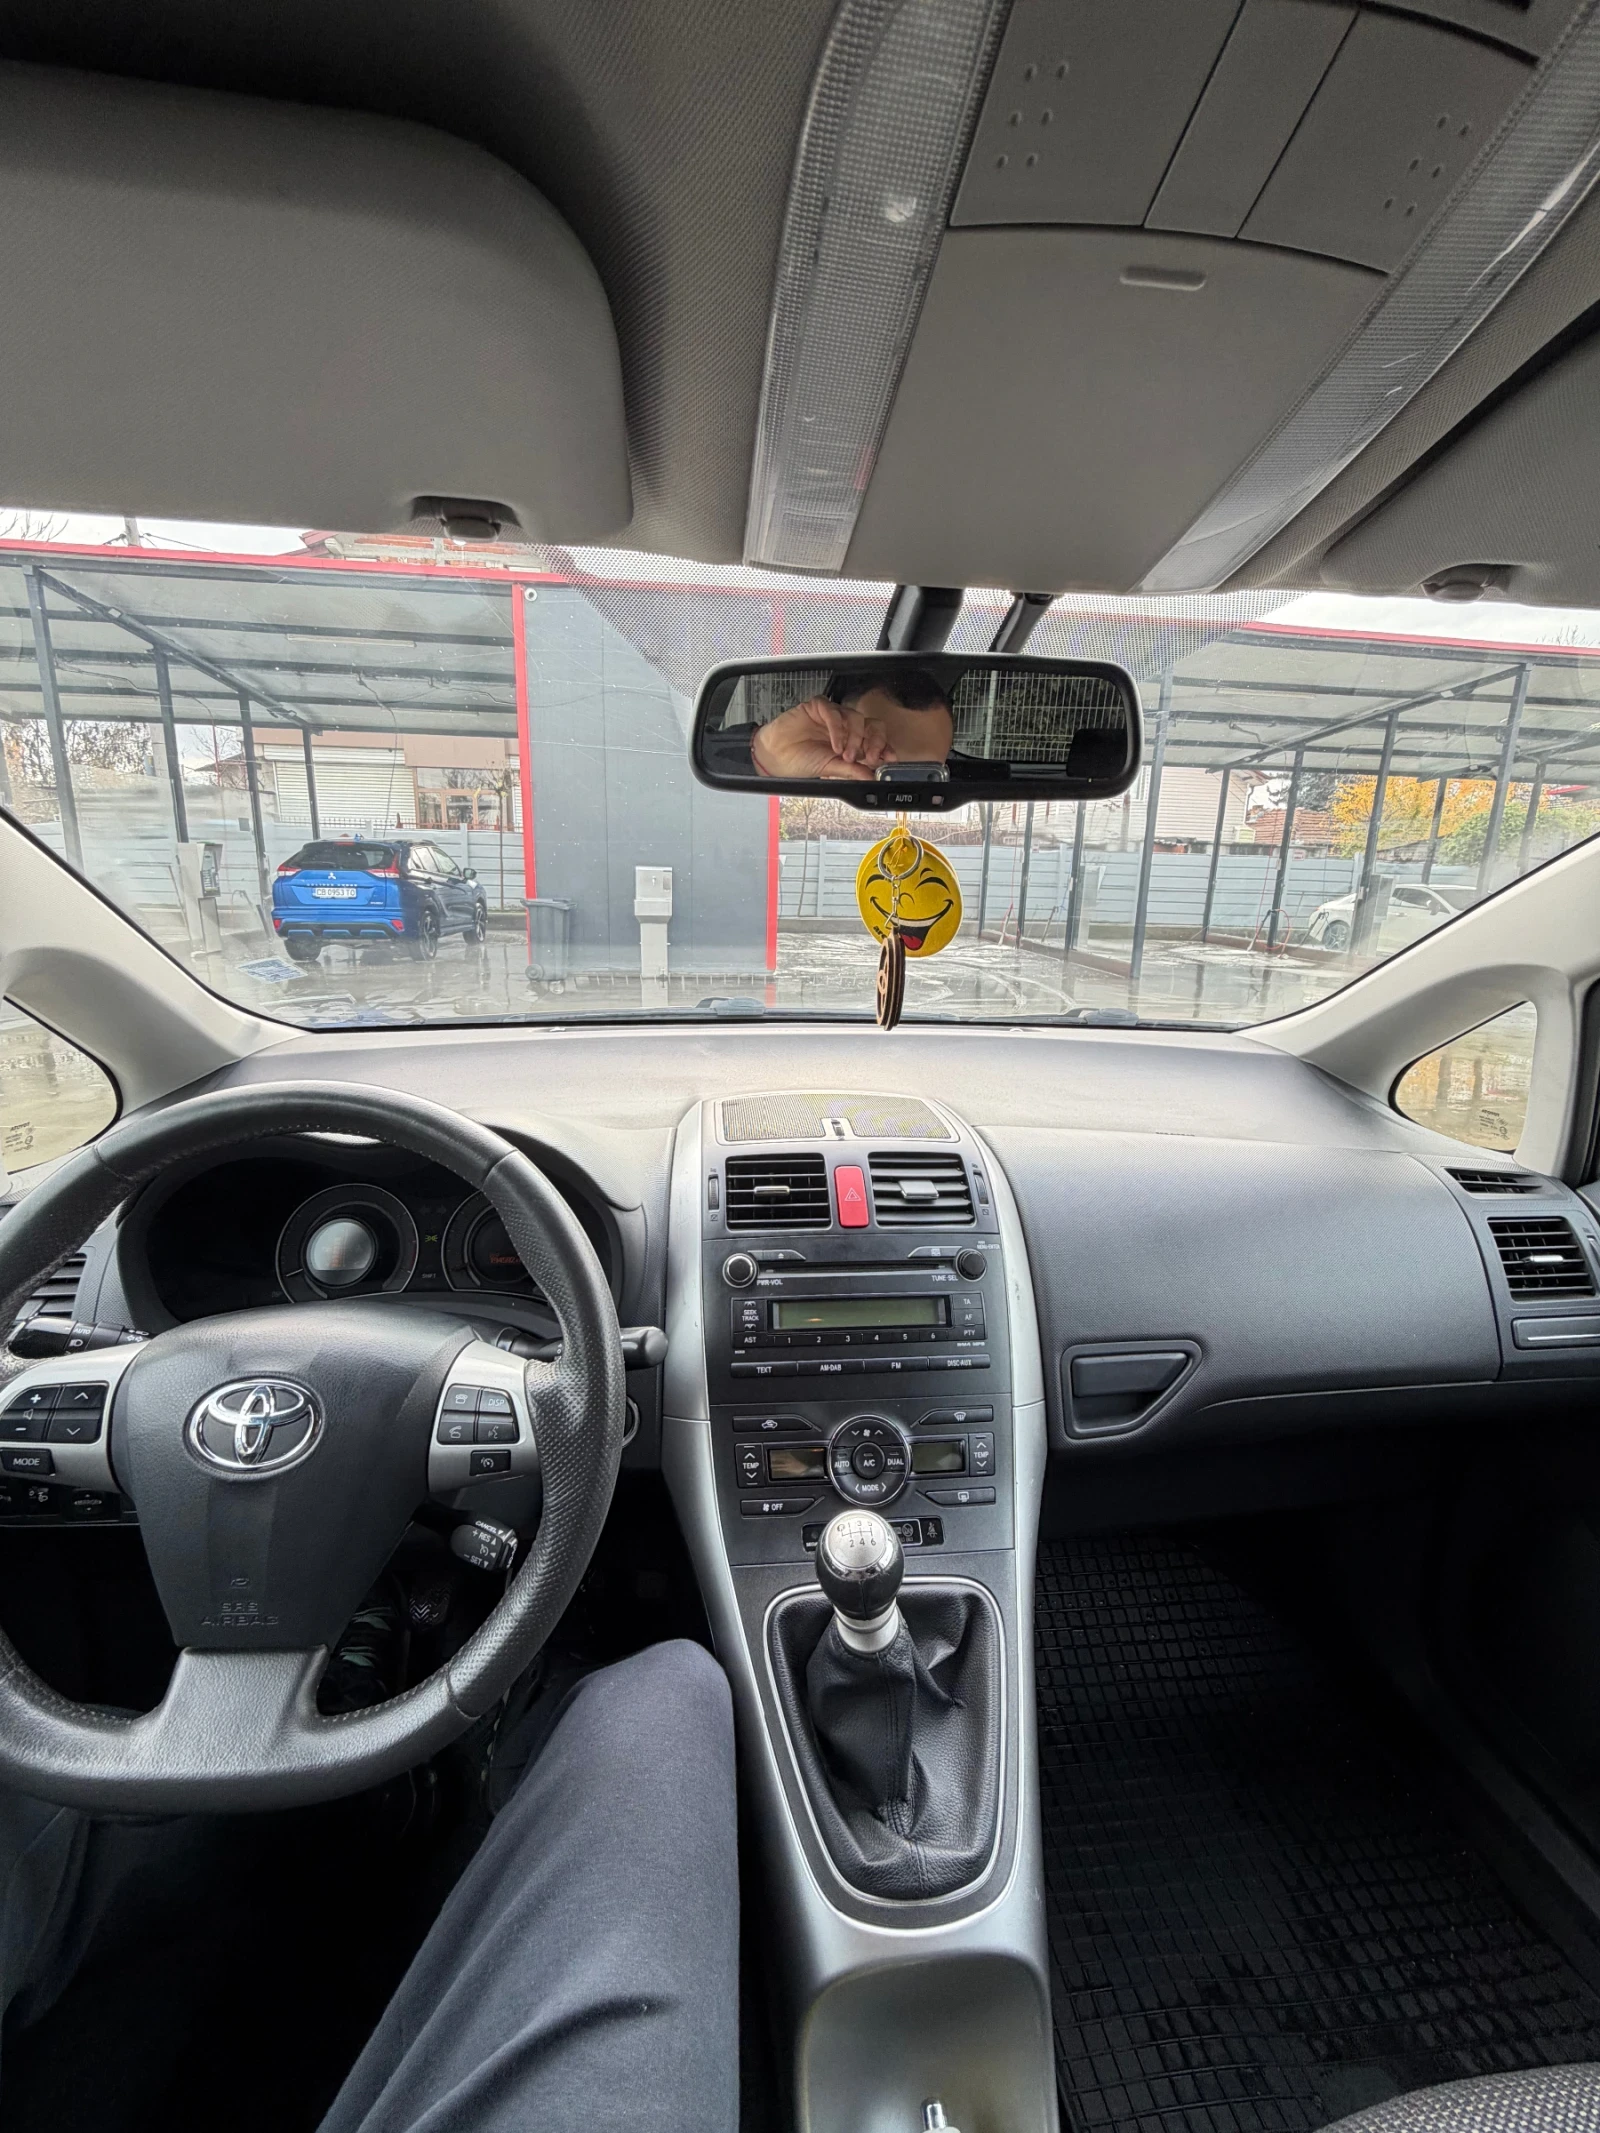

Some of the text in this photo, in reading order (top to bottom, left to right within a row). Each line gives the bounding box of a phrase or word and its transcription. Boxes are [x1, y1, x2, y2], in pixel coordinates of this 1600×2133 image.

[895, 794, 913, 803] AUTO
[316, 888, 327, 896] CB
[327, 888, 345, 896] 0953
[74, 1327, 91, 1335] AUTO
[743, 1336, 757, 1344] AST
[756, 1366, 773, 1374] TEXT
[488, 1398, 505, 1407] DISP
[973, 1451, 990, 1459] TEMP
[12, 1457, 41, 1466] MODE
[834, 1460, 850, 1468] AUTO
[863, 1459, 876, 1467] A/C
[887, 1458, 904, 1466] DUAL
[861, 1484, 880, 1492] MODE
[771, 1503, 784, 1511] OFF
[475, 1520, 497, 1534] CANCEL
[478, 1532, 492, 1543] RES
[859, 1537, 865, 1546] 4
[870, 1537, 877, 1546] 6
[849, 1539, 855, 1548] 2
[470, 1555, 483, 1566] SET
[221, 1602, 259, 1612] SRS
[201, 1615, 280, 1626] AIRBAG
